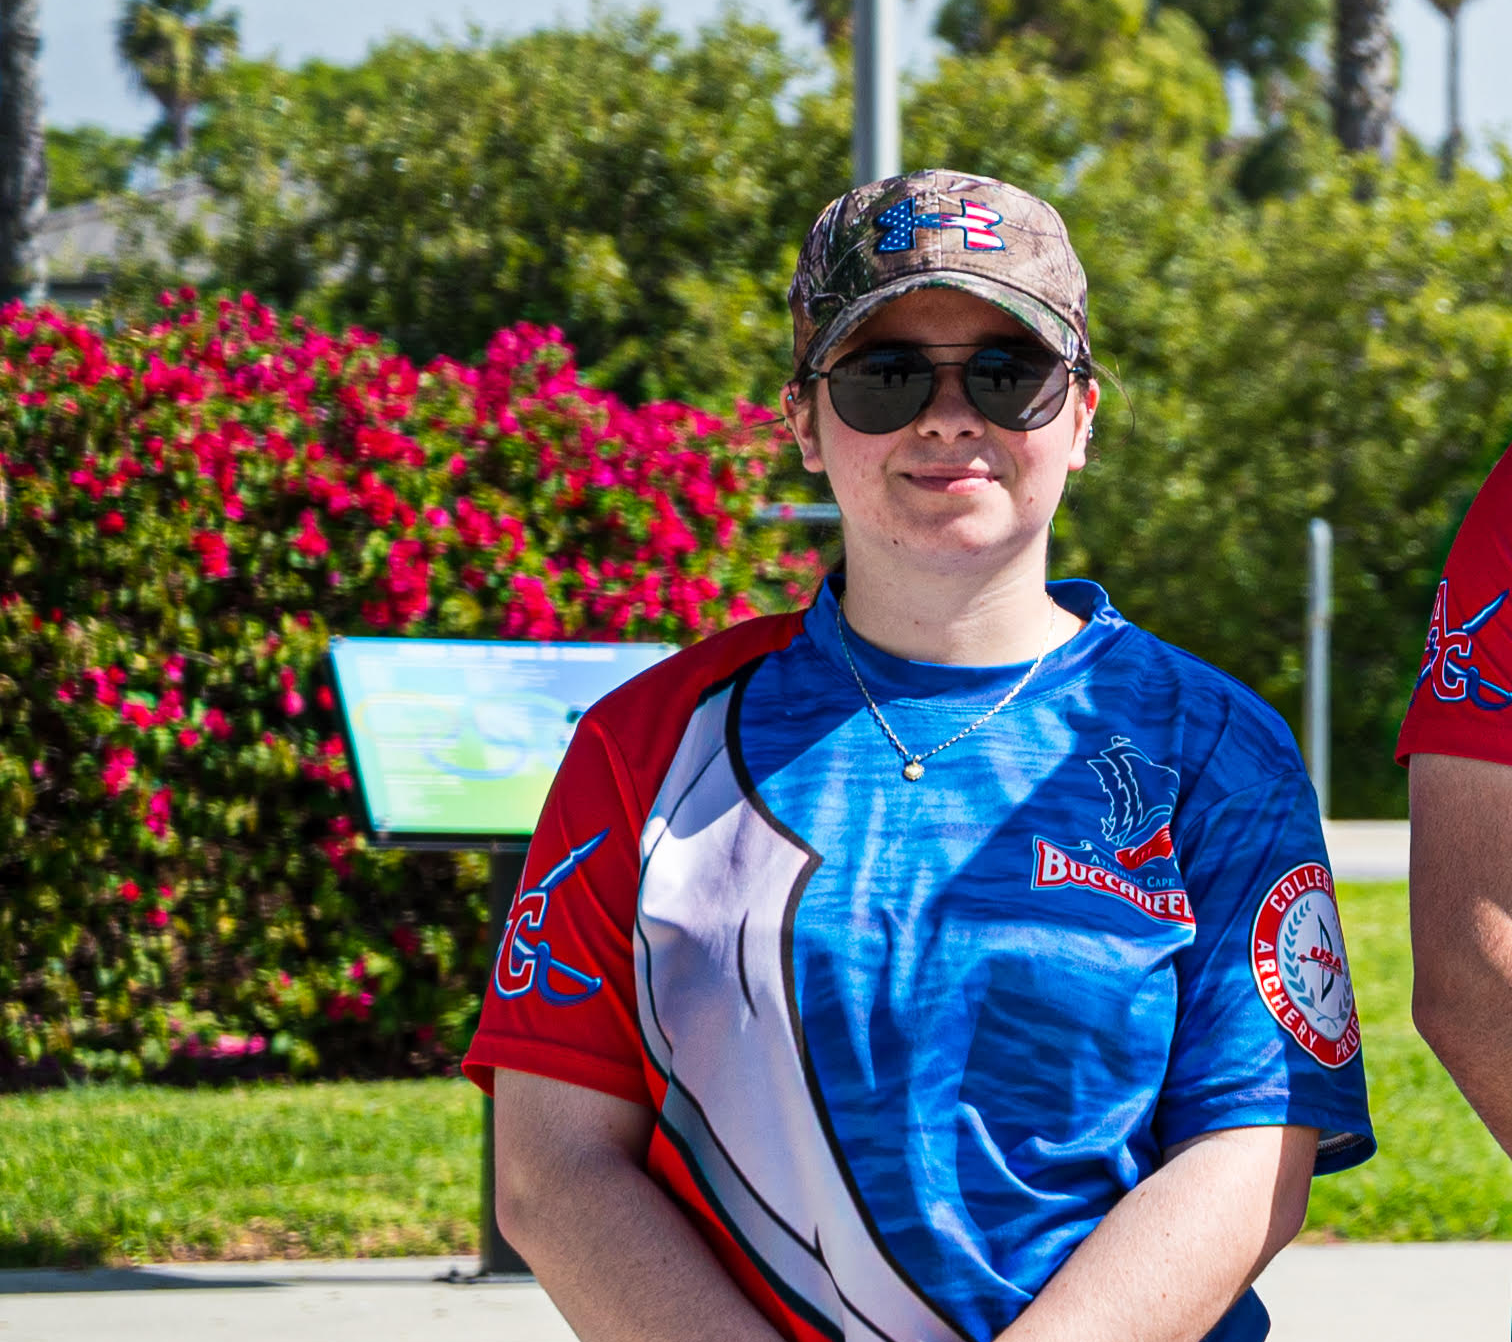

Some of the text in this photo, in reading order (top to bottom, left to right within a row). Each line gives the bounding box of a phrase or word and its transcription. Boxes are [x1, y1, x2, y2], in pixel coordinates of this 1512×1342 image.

[1146, 875, 1176, 888] CAPE
[1310, 946, 1342, 970] USA
[1257, 939, 1318, 1050] ARCHERY
